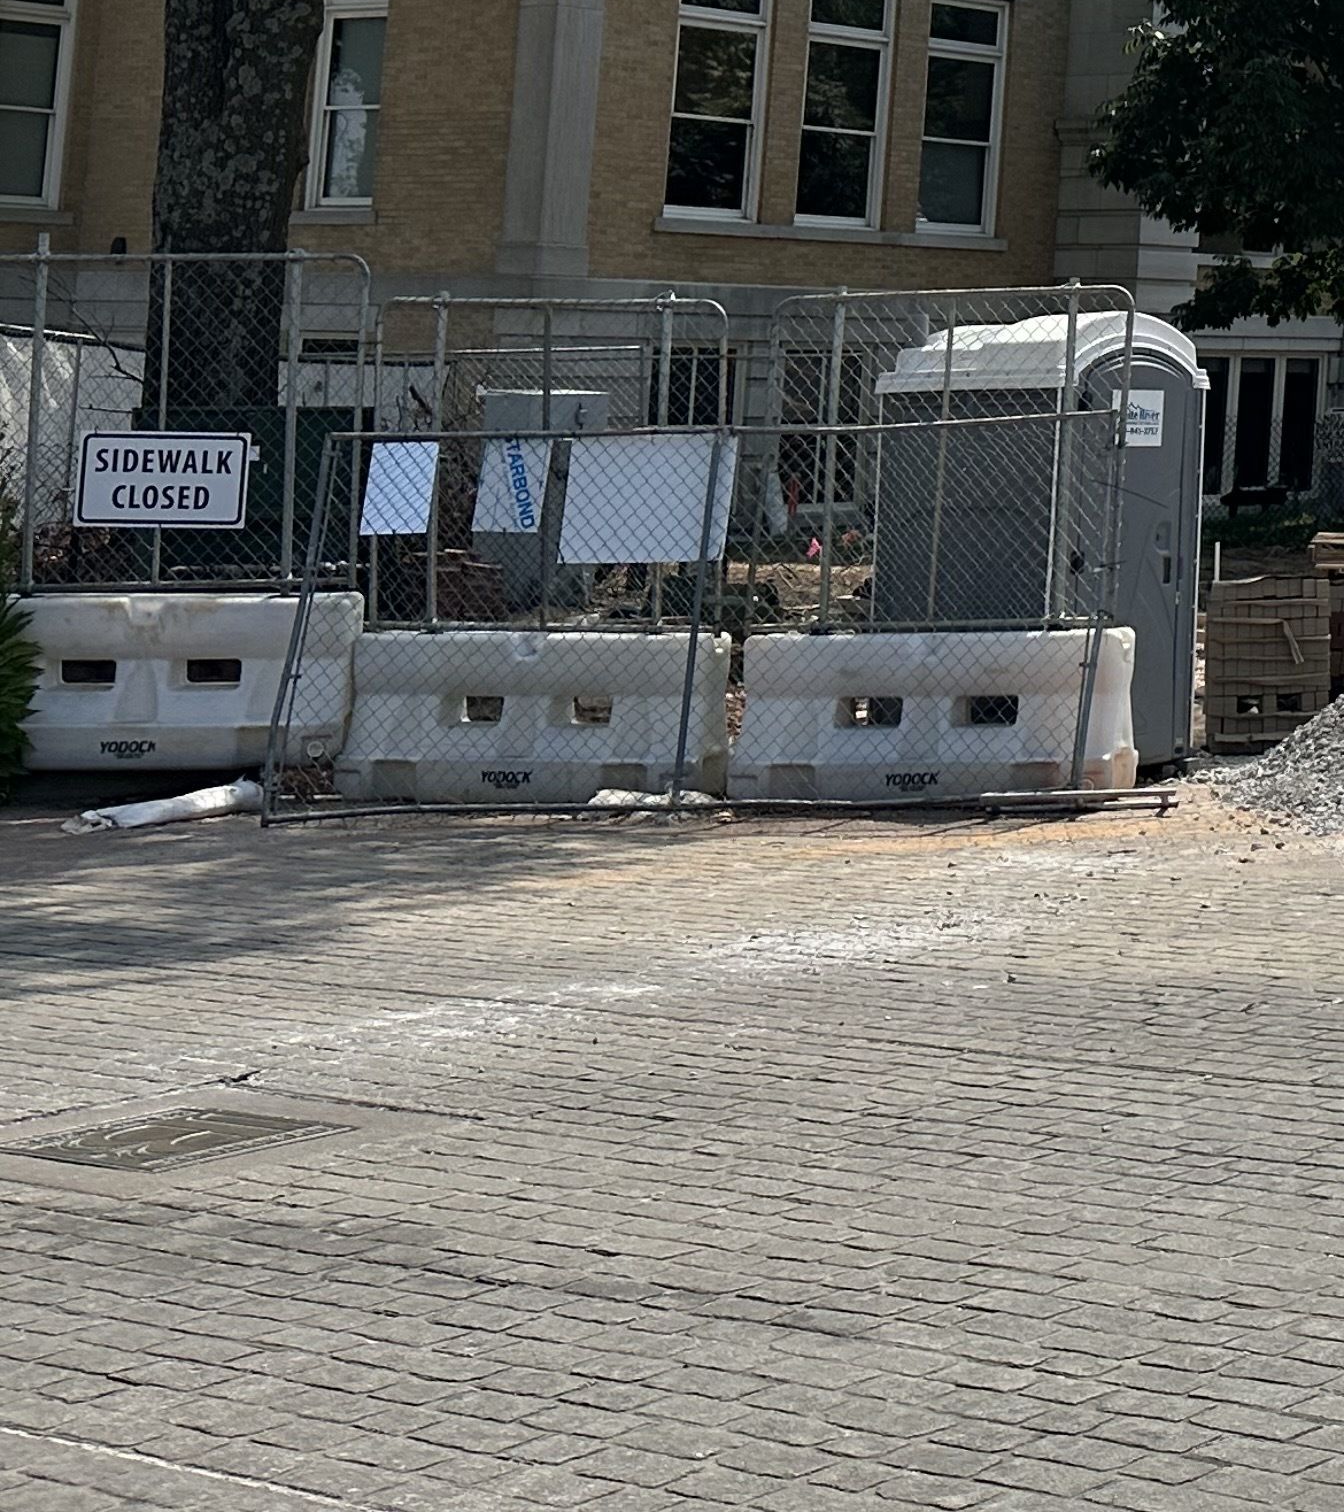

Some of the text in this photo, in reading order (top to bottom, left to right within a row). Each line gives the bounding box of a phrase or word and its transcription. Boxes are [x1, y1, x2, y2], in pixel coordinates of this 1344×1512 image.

[94, 448, 233, 474] SIDEWALK
[507, 436, 535, 529] TARBOND
[111, 484, 210, 510] CLOSED
[100, 740, 156, 754] YODOCK
[885, 771, 940, 786] YODOCK
